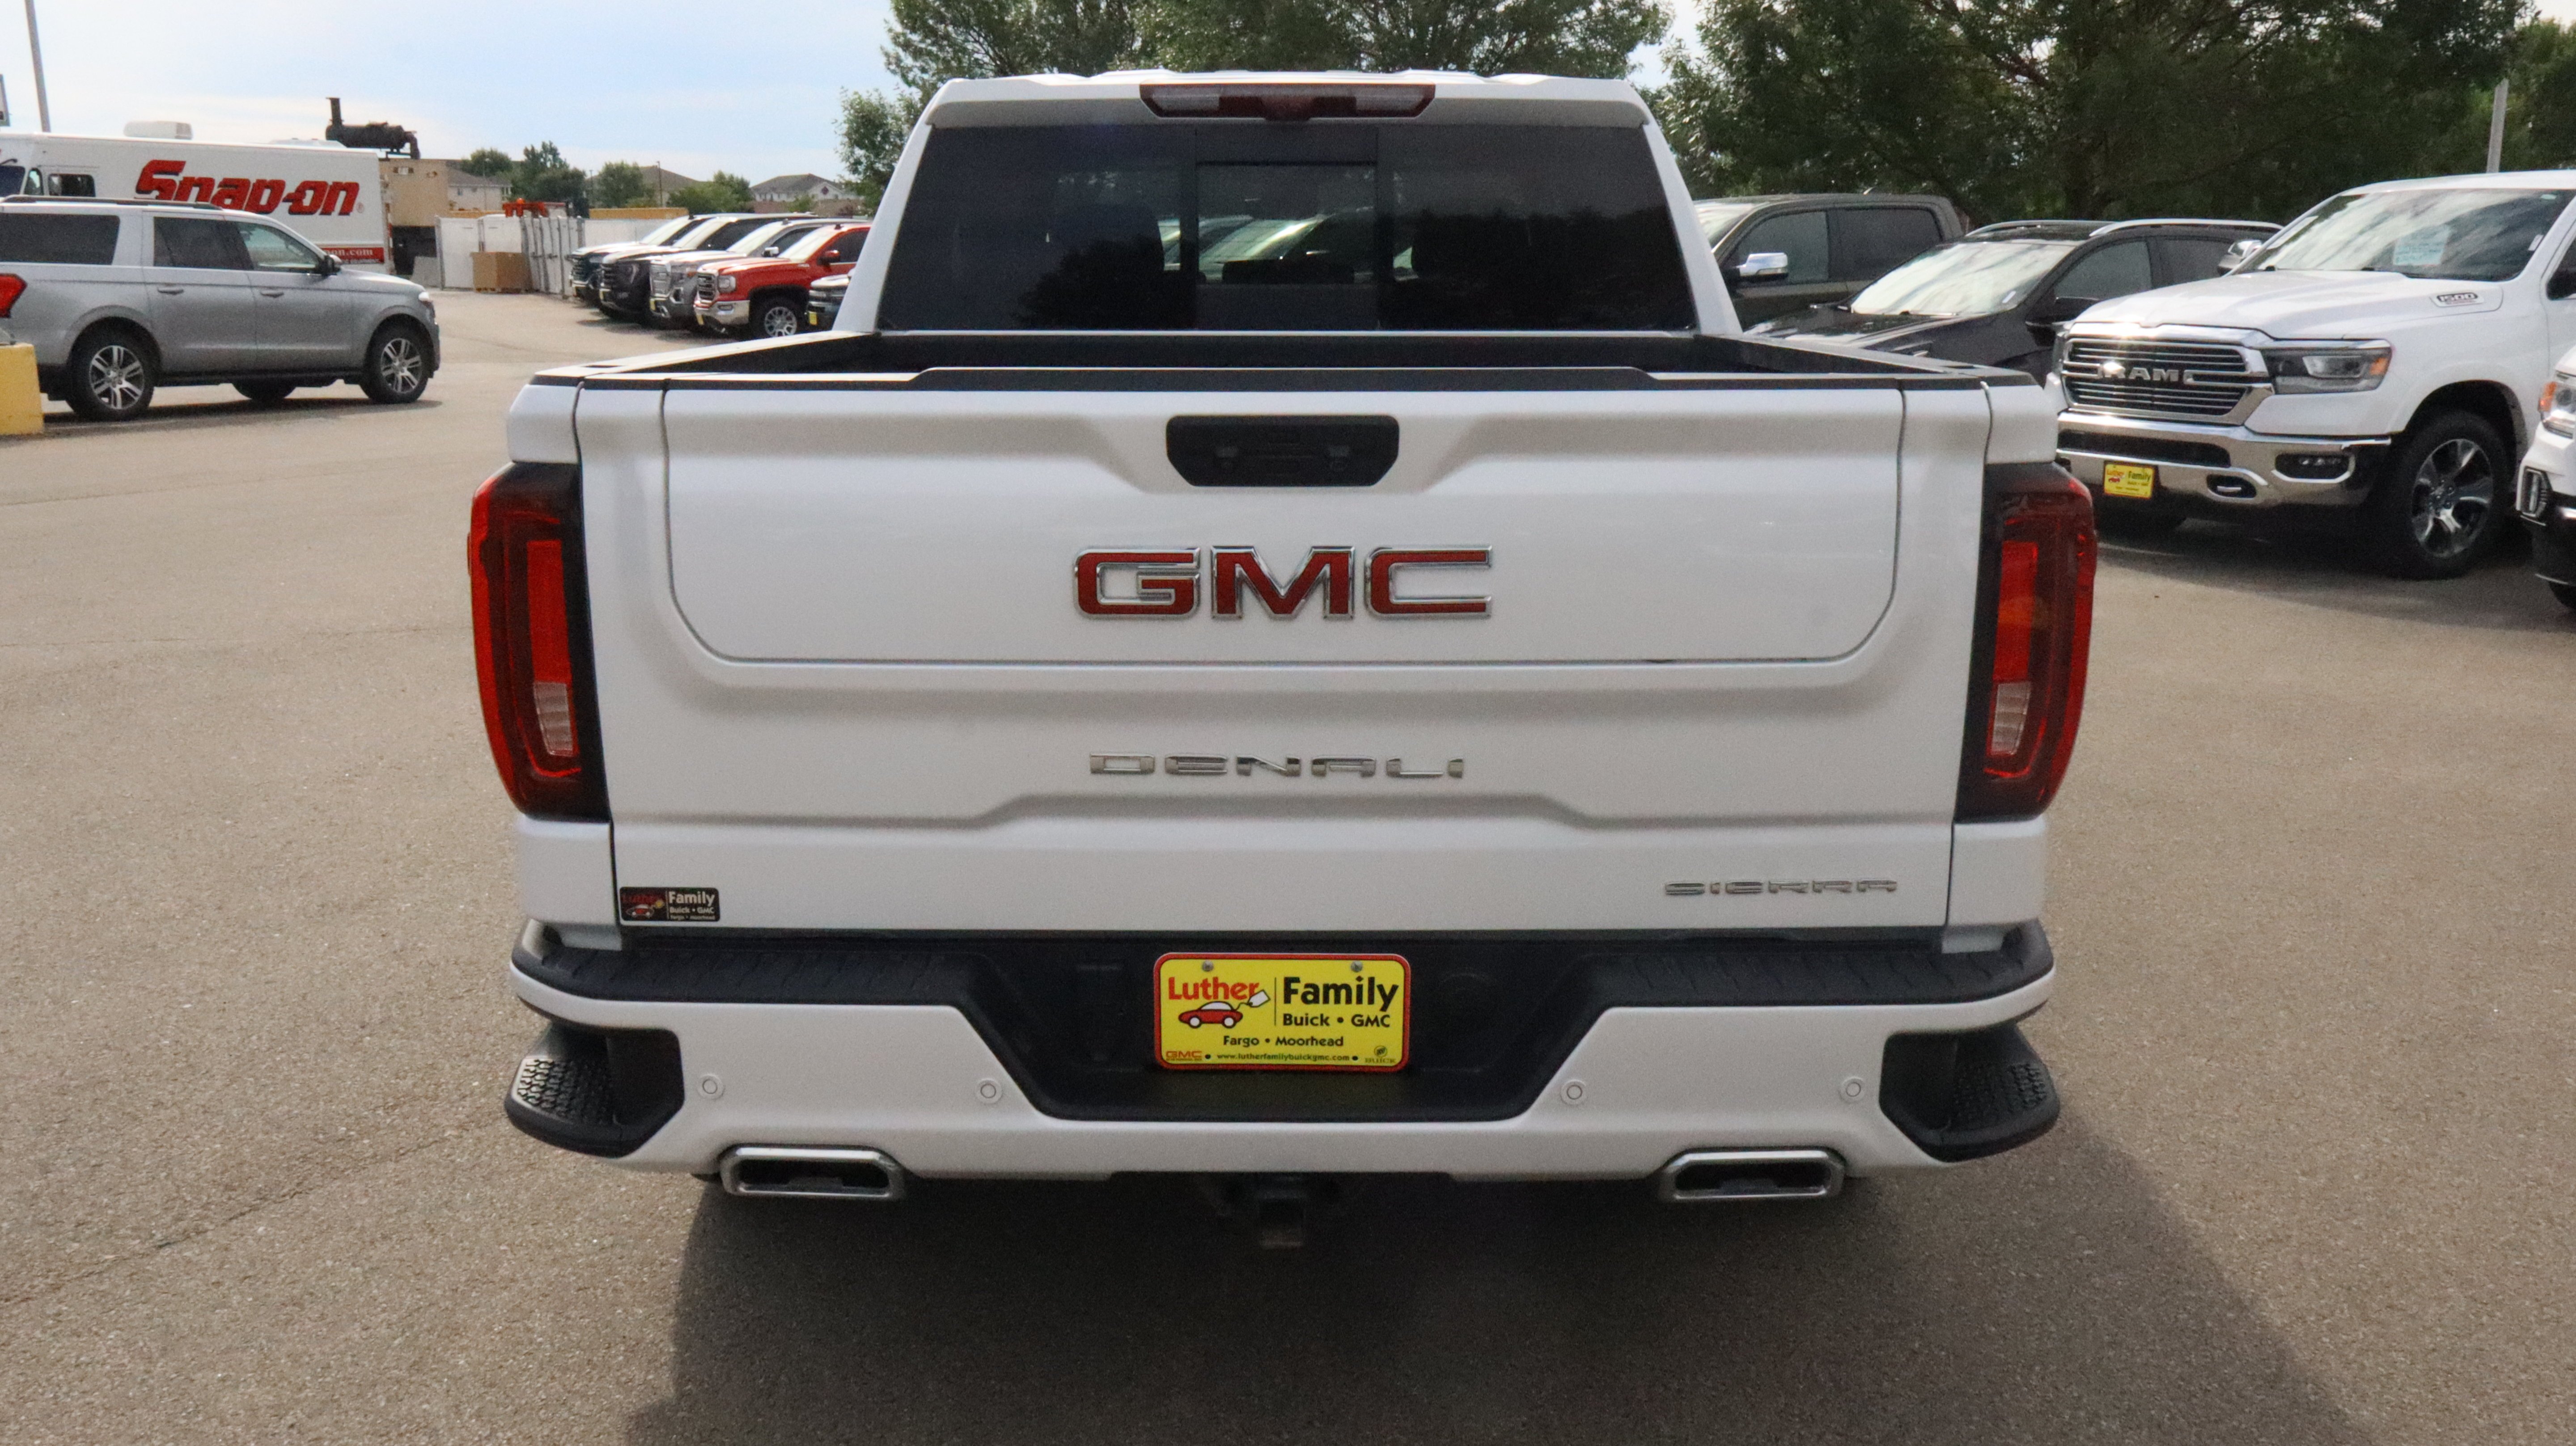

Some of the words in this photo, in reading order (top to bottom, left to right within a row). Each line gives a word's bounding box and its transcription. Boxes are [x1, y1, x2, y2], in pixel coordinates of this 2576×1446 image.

[136, 159, 360, 216] Snap-on
[2103, 361, 2179, 382] RAM
[1074, 545, 1492, 620] GMC
[1089, 752, 1464, 779] DENALI
[1665, 880, 1897, 895] SIERRA
[669, 891, 715, 906] Family
[1168, 976, 1259, 1000] Luther
[1283, 976, 1399, 1012] Family
[1283, 1013, 1330, 1026] Buick
[1351, 1014, 1390, 1027] GMC
[1223, 1036, 1259, 1047] Fargo
[1275, 1036, 1343, 1047] Moorhead
[1217, 1052, 1349, 1061] www.lutherfamilybuickgmc.com
